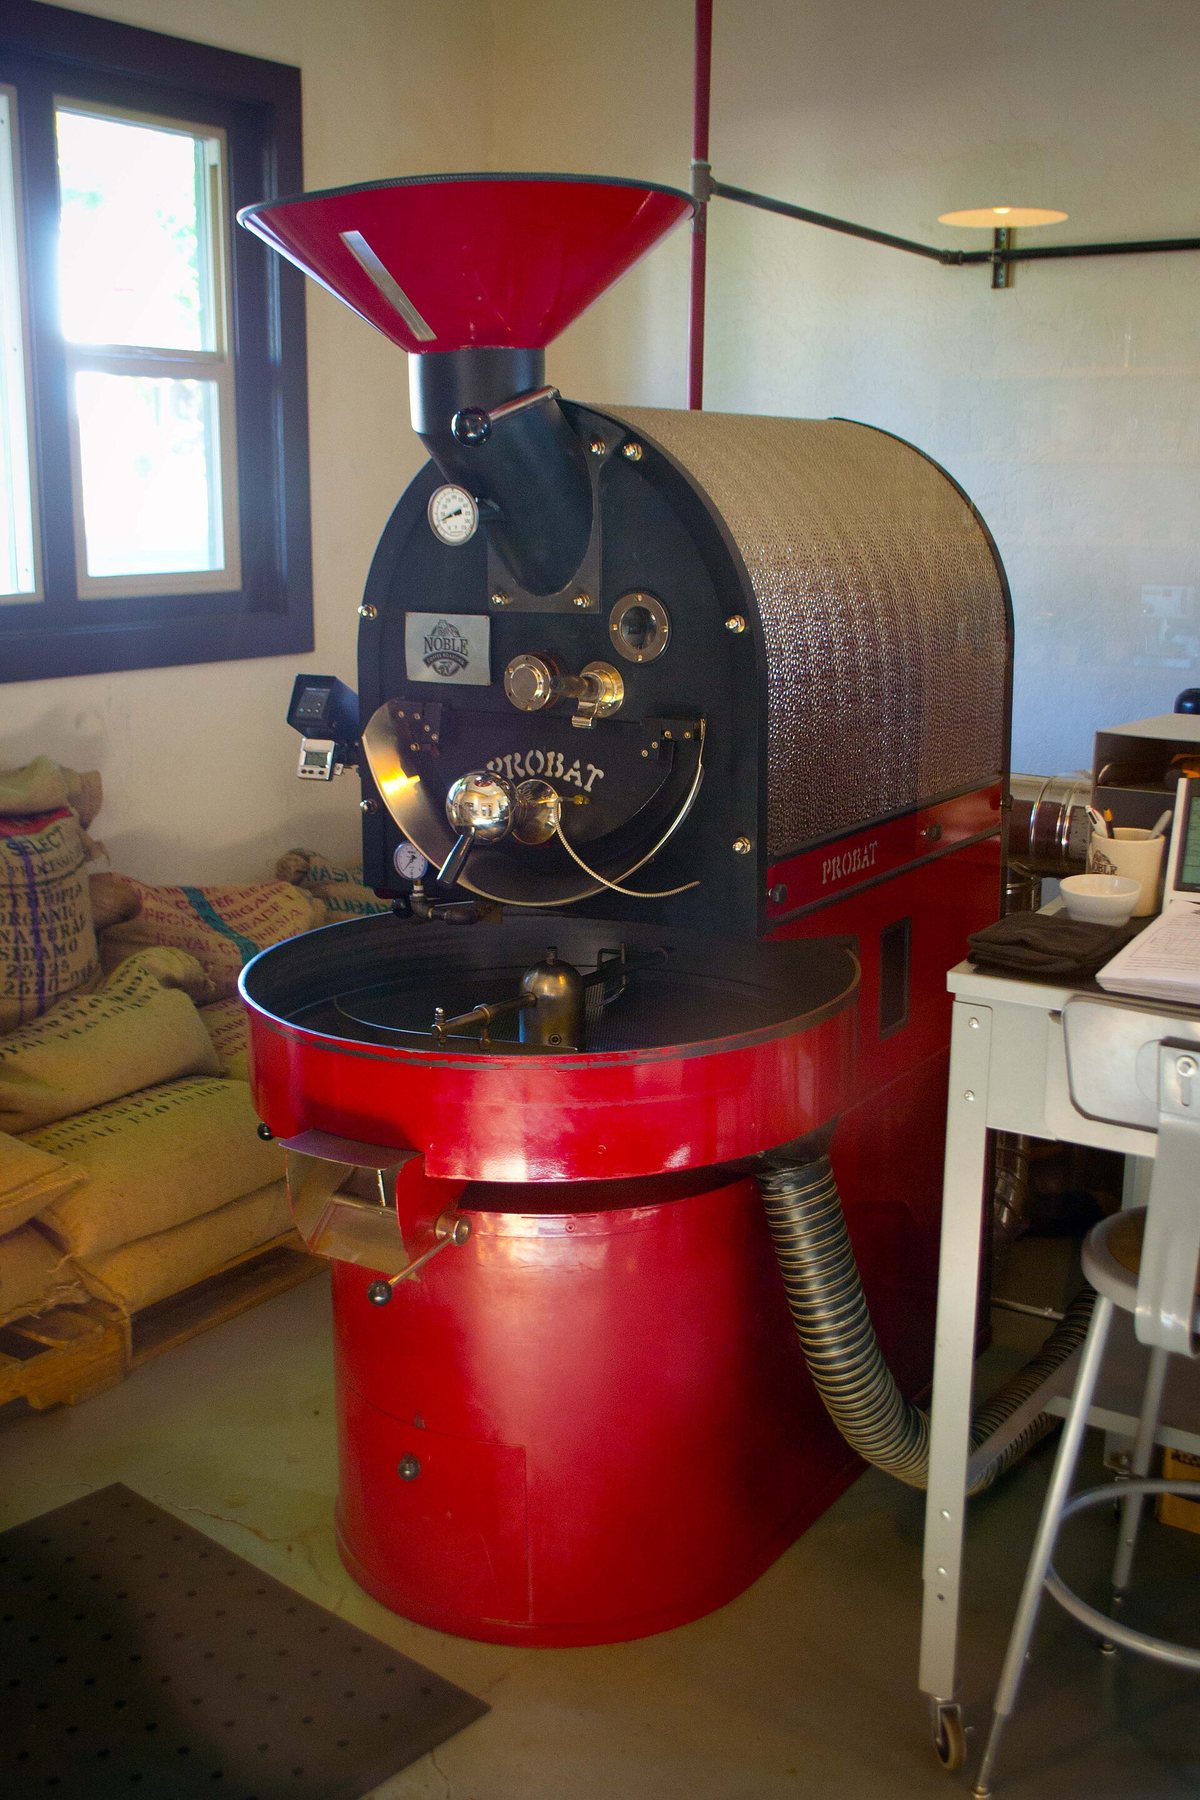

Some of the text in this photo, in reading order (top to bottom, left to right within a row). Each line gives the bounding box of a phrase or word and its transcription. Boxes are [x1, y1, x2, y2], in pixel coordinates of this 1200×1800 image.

[423, 635, 469, 657] NOBLE
[7, 825, 66, 856] SELECT
[821, 840, 878, 885] PROBAT
[1090, 863, 1118, 876] OBLE
